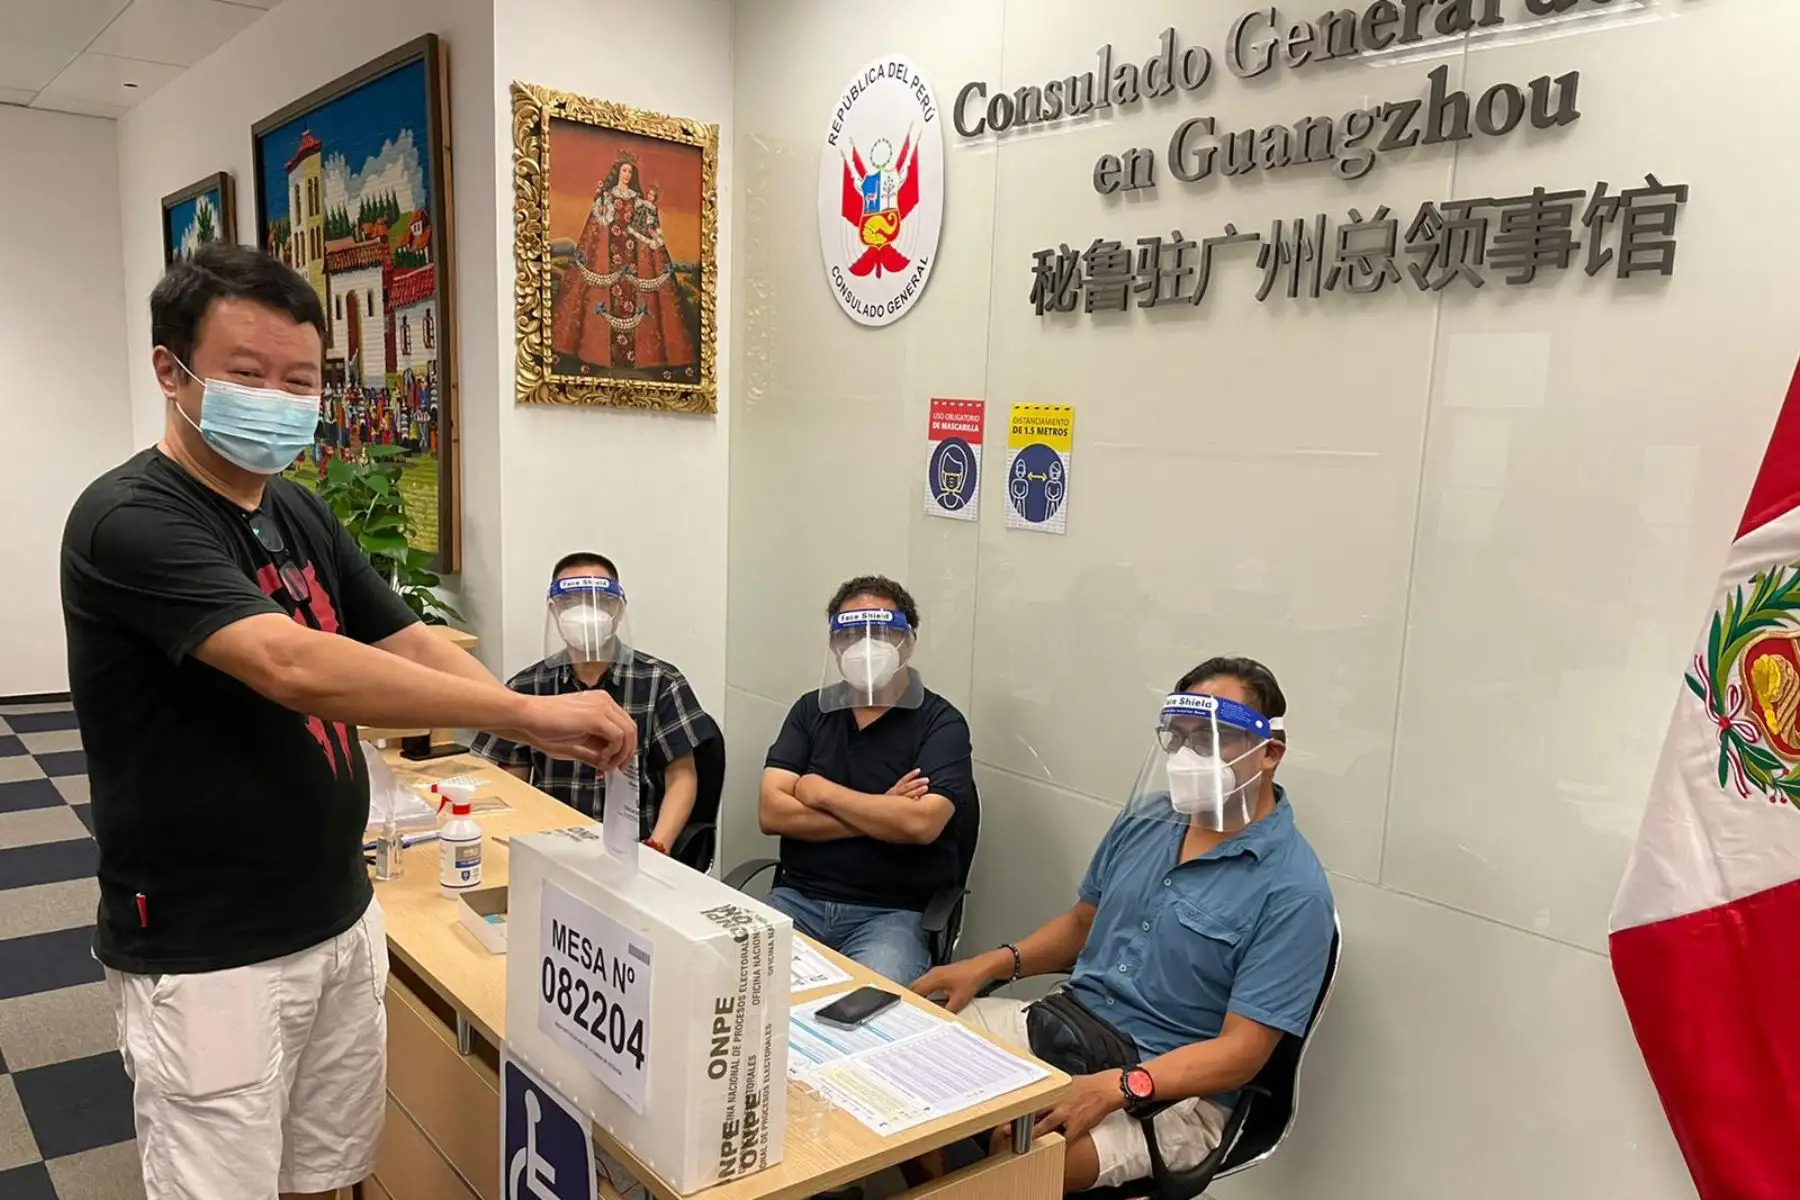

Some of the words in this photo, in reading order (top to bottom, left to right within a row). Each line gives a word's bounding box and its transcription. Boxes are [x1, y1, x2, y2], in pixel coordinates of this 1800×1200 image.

[828, 64, 885, 147] REPÚBLICA
[888, 62, 909, 82] DEL
[911, 75, 936, 124] PERÚ
[953, 26, 1212, 137] Consulado
[1093, 146, 1157, 195] en
[1167, 64, 1580, 181] Guangzhou
[1029, 172, 1689, 317] 秘鲁驻广州总领事馆
[831, 264, 885, 318] CONSULADO
[887, 255, 929, 313] GENERAL
[932, 421, 941, 429] DE
[942, 422, 979, 432] MASCARILLA
[933, 412, 945, 420] USO
[945, 413, 981, 423] OBLIGATORIO
[1012, 426, 1023, 435] DE
[1024, 426, 1035, 435] 1.5
[1036, 427, 1068, 437] METROS
[1013, 416, 1070, 427] DISTANCIAMIENTO
[1179, 697, 1212, 708] Shield
[552, 918, 607, 982] MESA
[739, 940, 749, 993] ELECTORAL
[751, 967, 761, 1006] OFICINA
[541, 955, 645, 1071] 082204
[707, 996, 735, 1080] ONPE
[733, 993, 746, 1042] PROCESOS
[732, 1041, 742, 1057] DE
[745, 1054, 757, 1095] TORALES
[728, 1060, 740, 1103] NACIONAL
[718, 1119, 740, 1179] NPE
